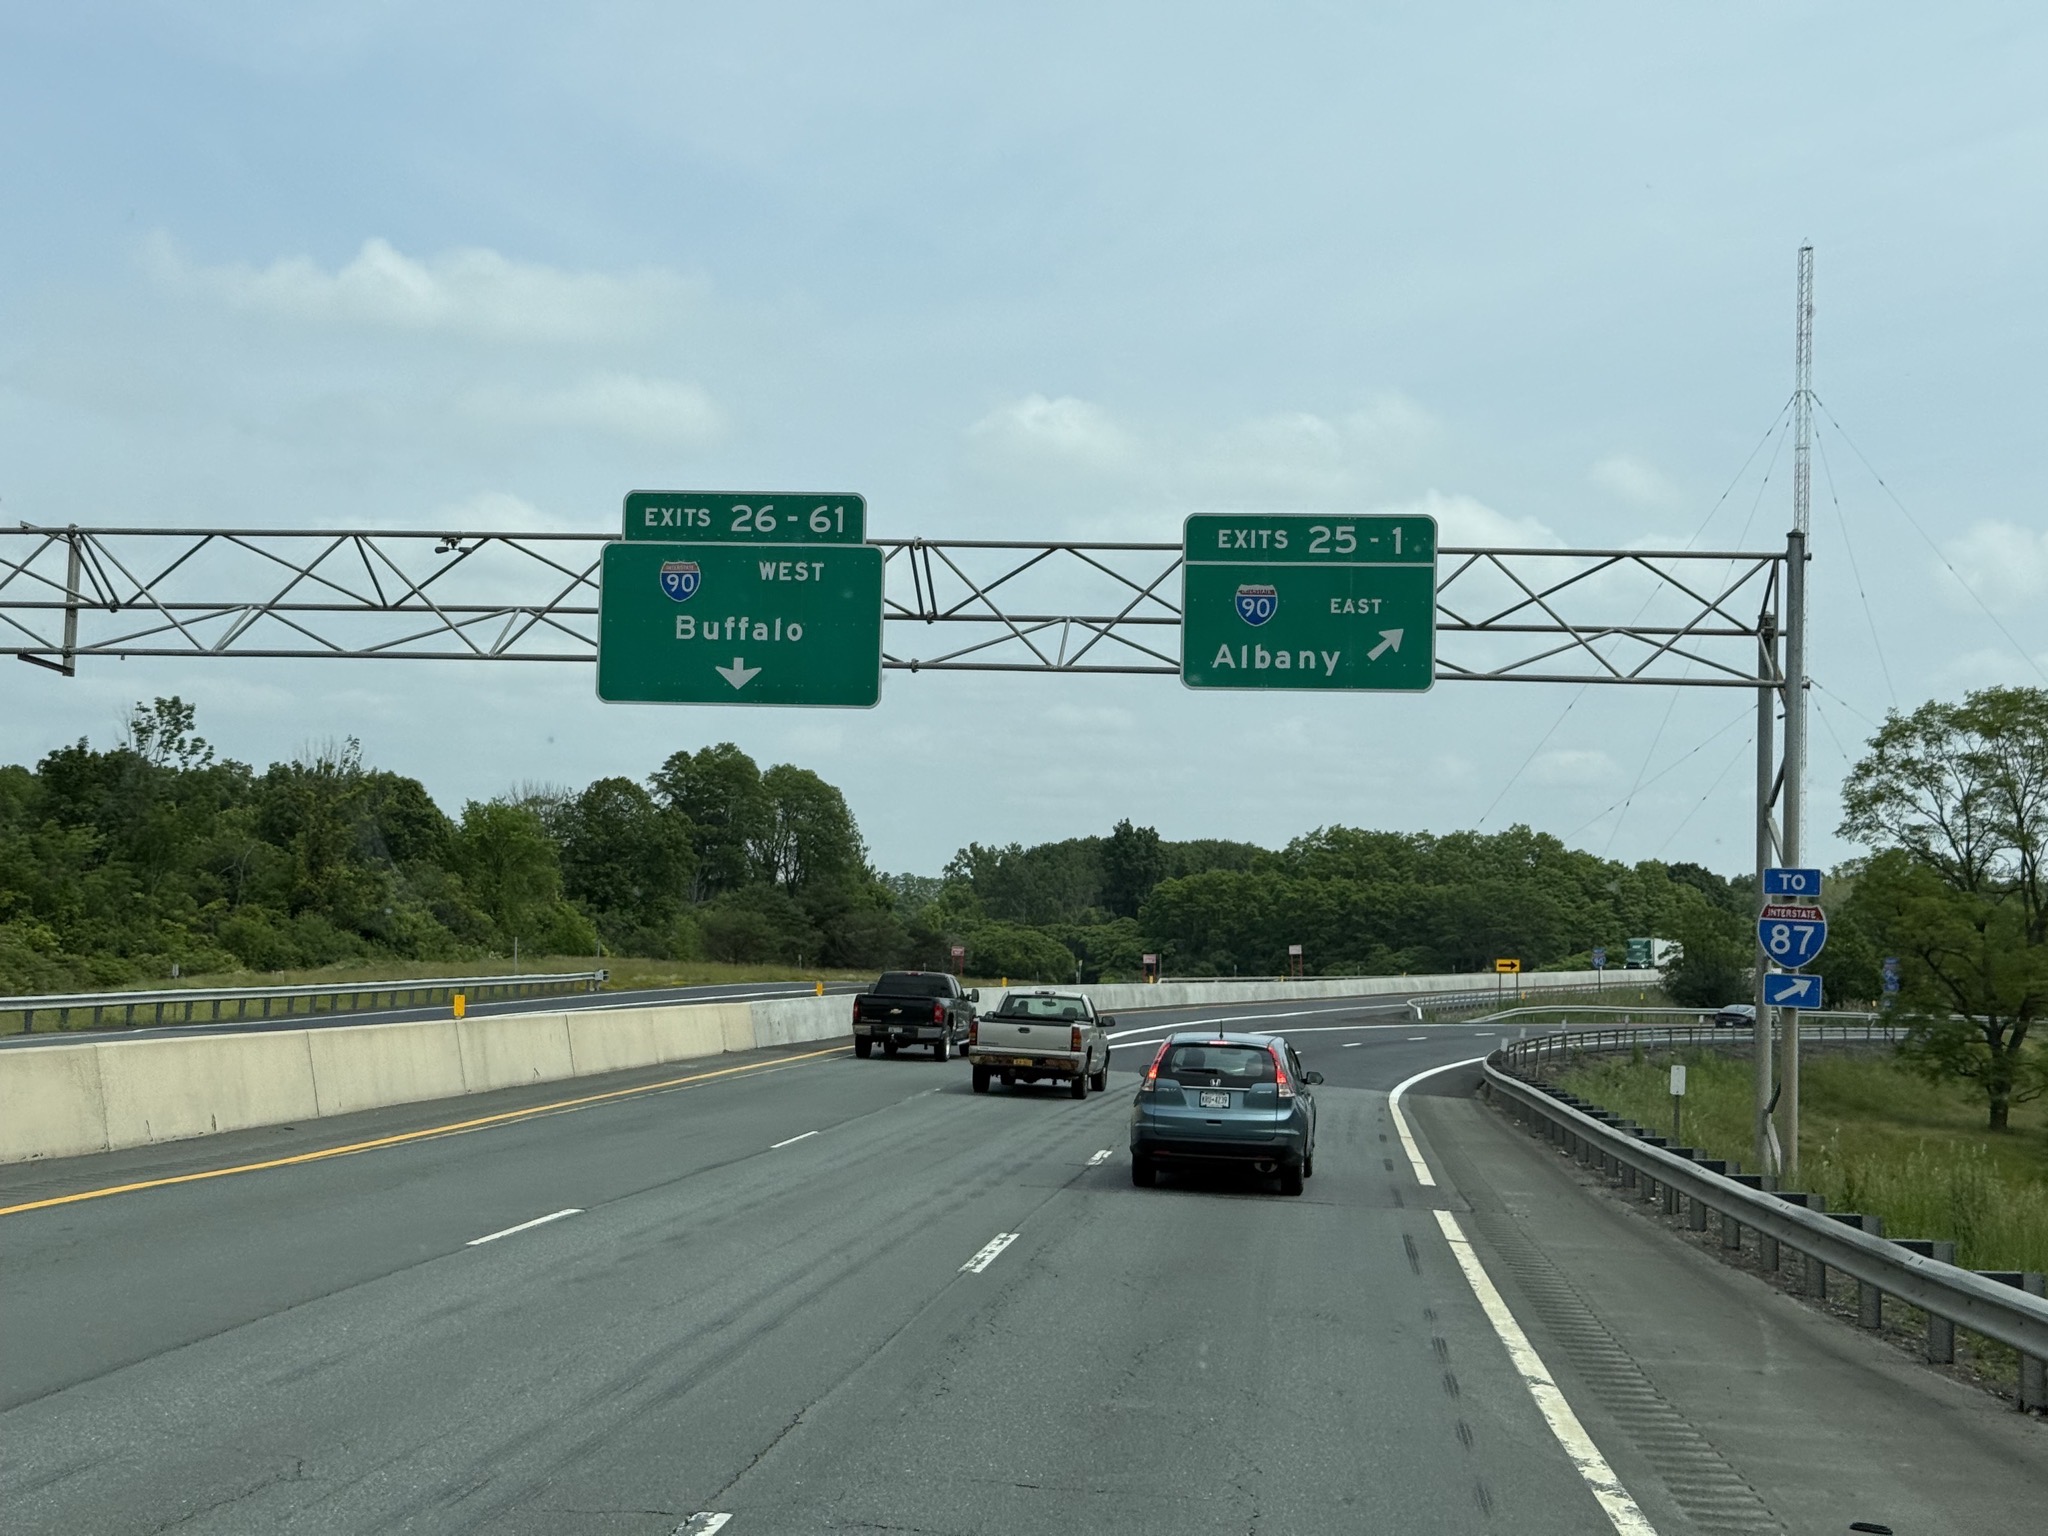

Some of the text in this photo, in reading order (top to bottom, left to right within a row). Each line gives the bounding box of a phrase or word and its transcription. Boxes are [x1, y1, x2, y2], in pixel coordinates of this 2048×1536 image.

[645, 508, 711, 527] EXITS
[731, 504, 777, 532] 26
[809, 506, 844, 533] 61
[1218, 529, 1288, 549] EXITS
[1309, 526, 1357, 554] 25
[1392, 526, 1402, 554] 1
[759, 561, 825, 582] WEST
[667, 574, 694, 592] 90
[1242, 598, 1270, 617] 90
[1331, 598, 1382, 614] EAST
[676, 615, 803, 641] Buffalo
[1212, 643, 1340, 676] Albany
[1779, 873, 1806, 890] TO
[1767, 908, 1816, 919] INTERSTATE
[1770, 924, 1814, 955] 87
